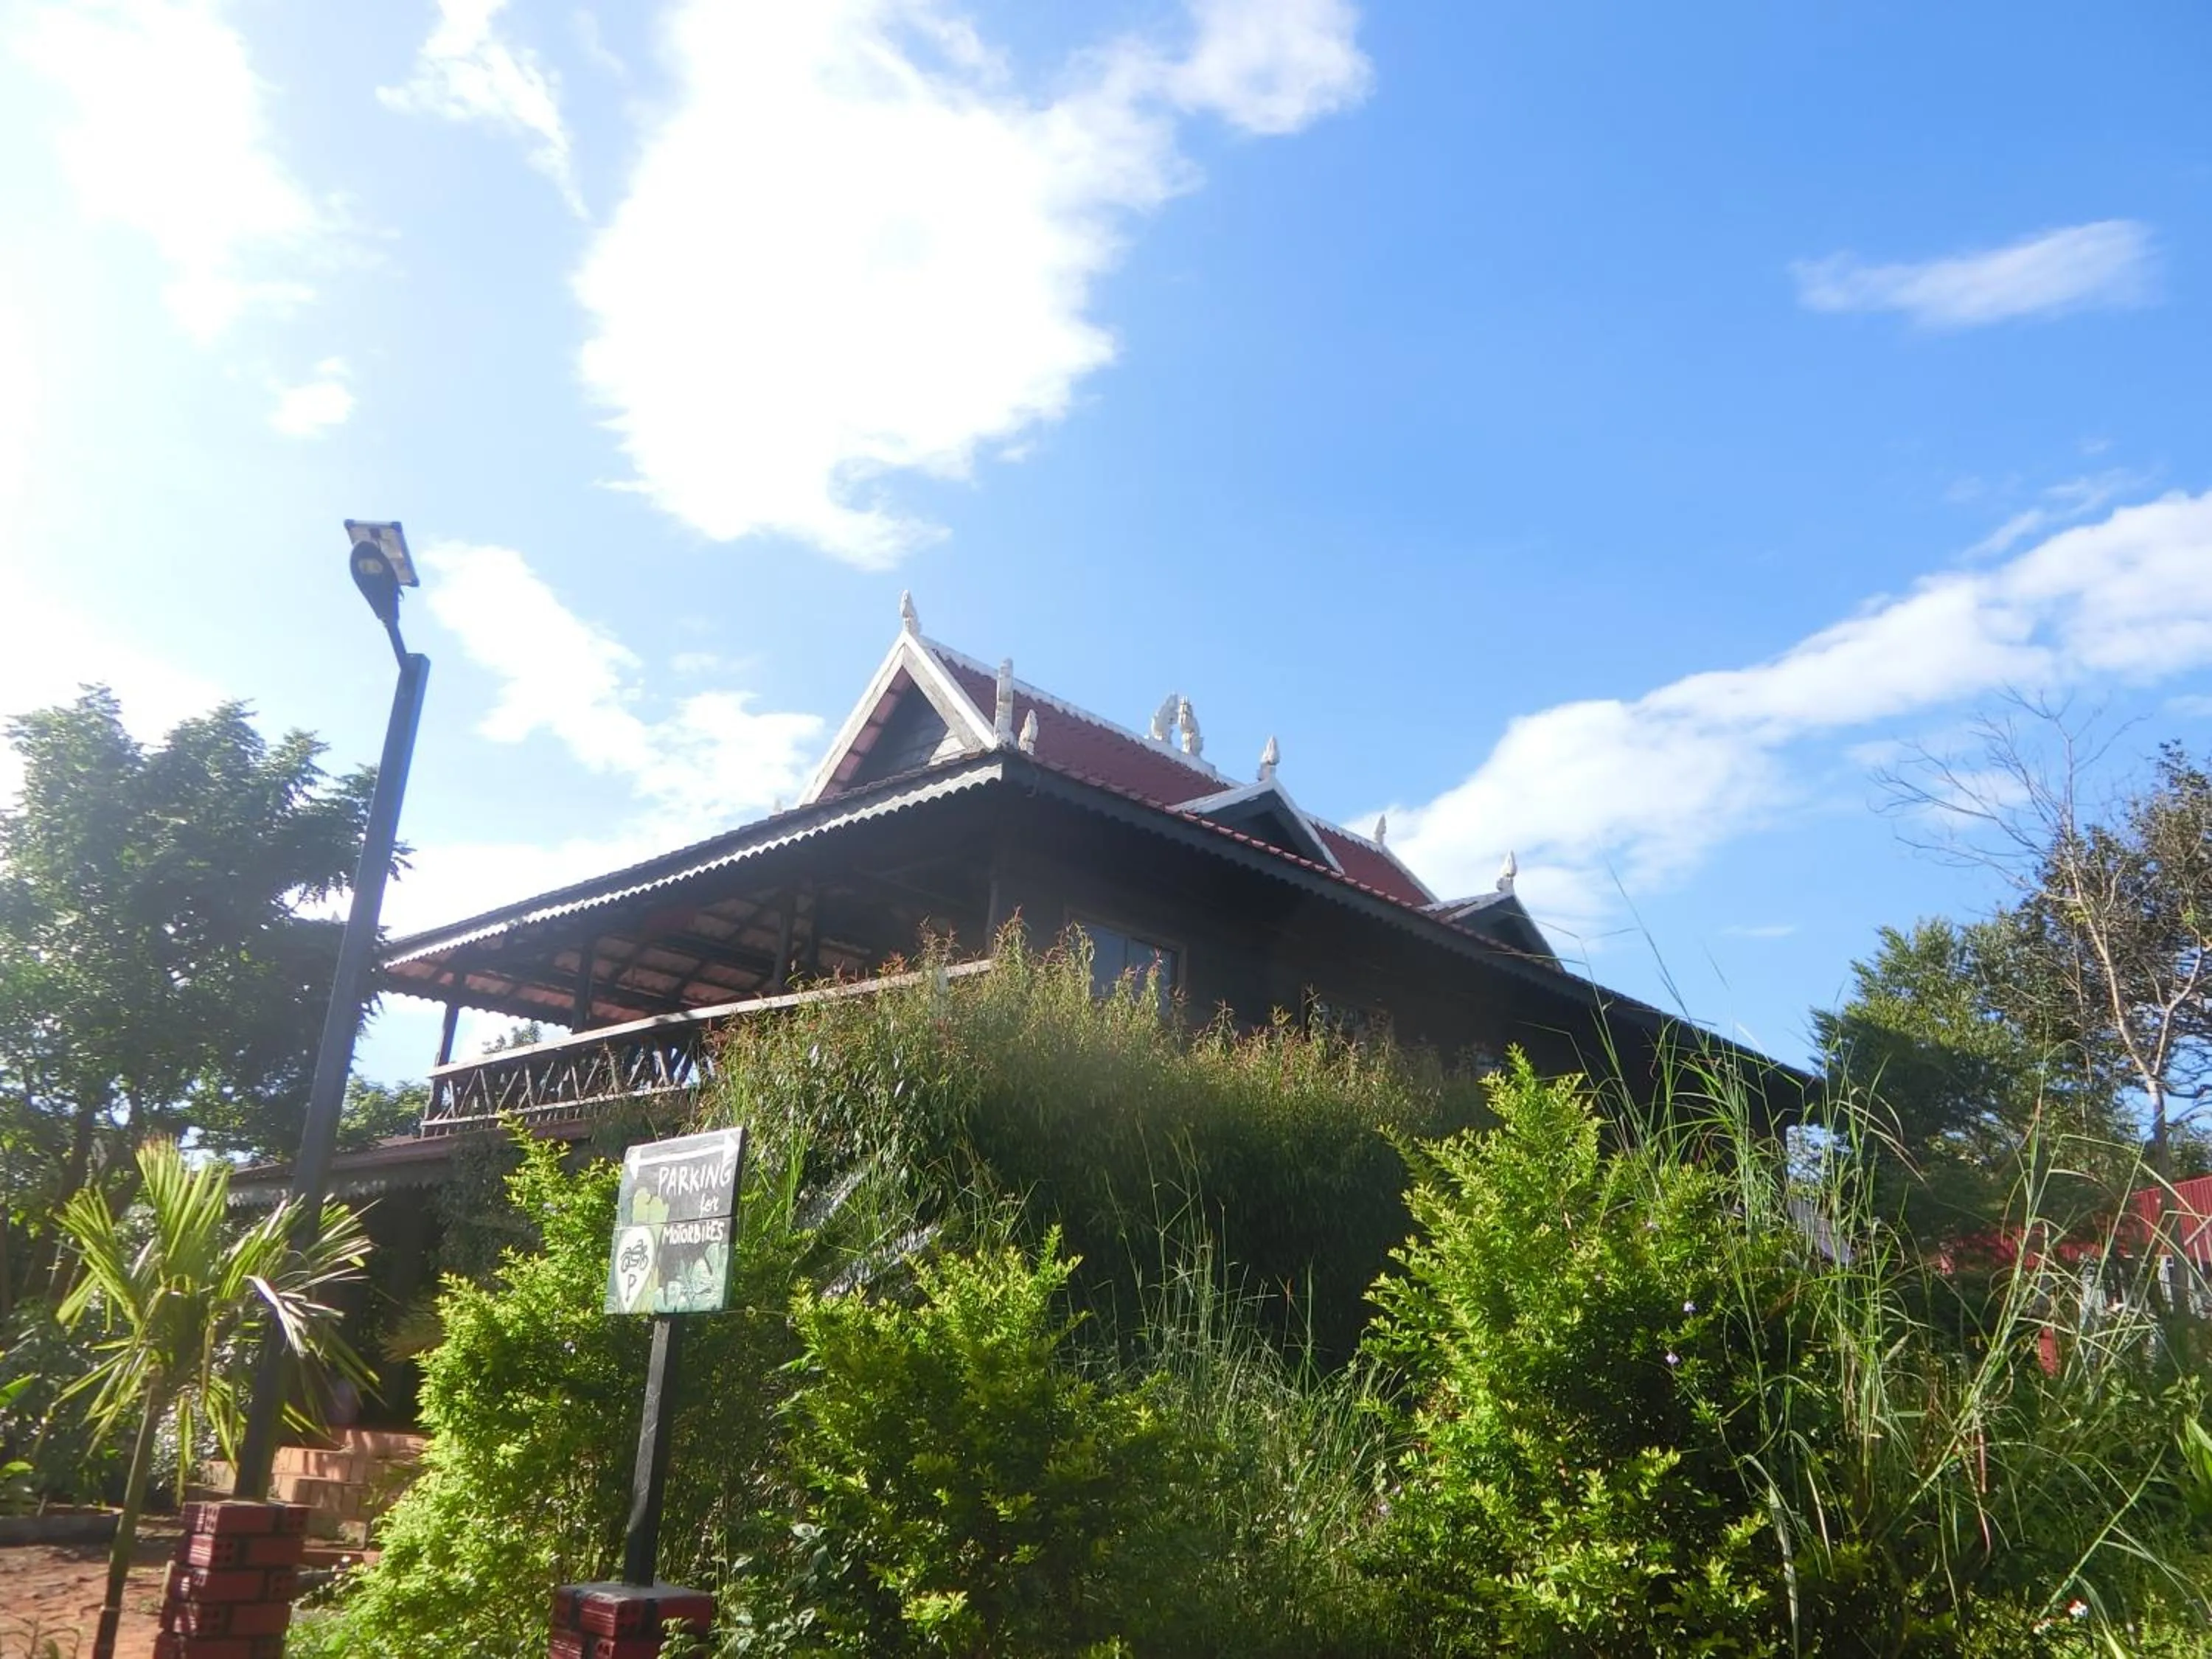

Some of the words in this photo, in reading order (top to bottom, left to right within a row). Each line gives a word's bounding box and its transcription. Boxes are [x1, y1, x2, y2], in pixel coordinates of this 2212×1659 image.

[658, 1160, 732, 1195] PARKING
[699, 1193, 719, 1218] for
[662, 1220, 725, 1245] MOTORBIKES
[626, 1274, 637, 1302] P
